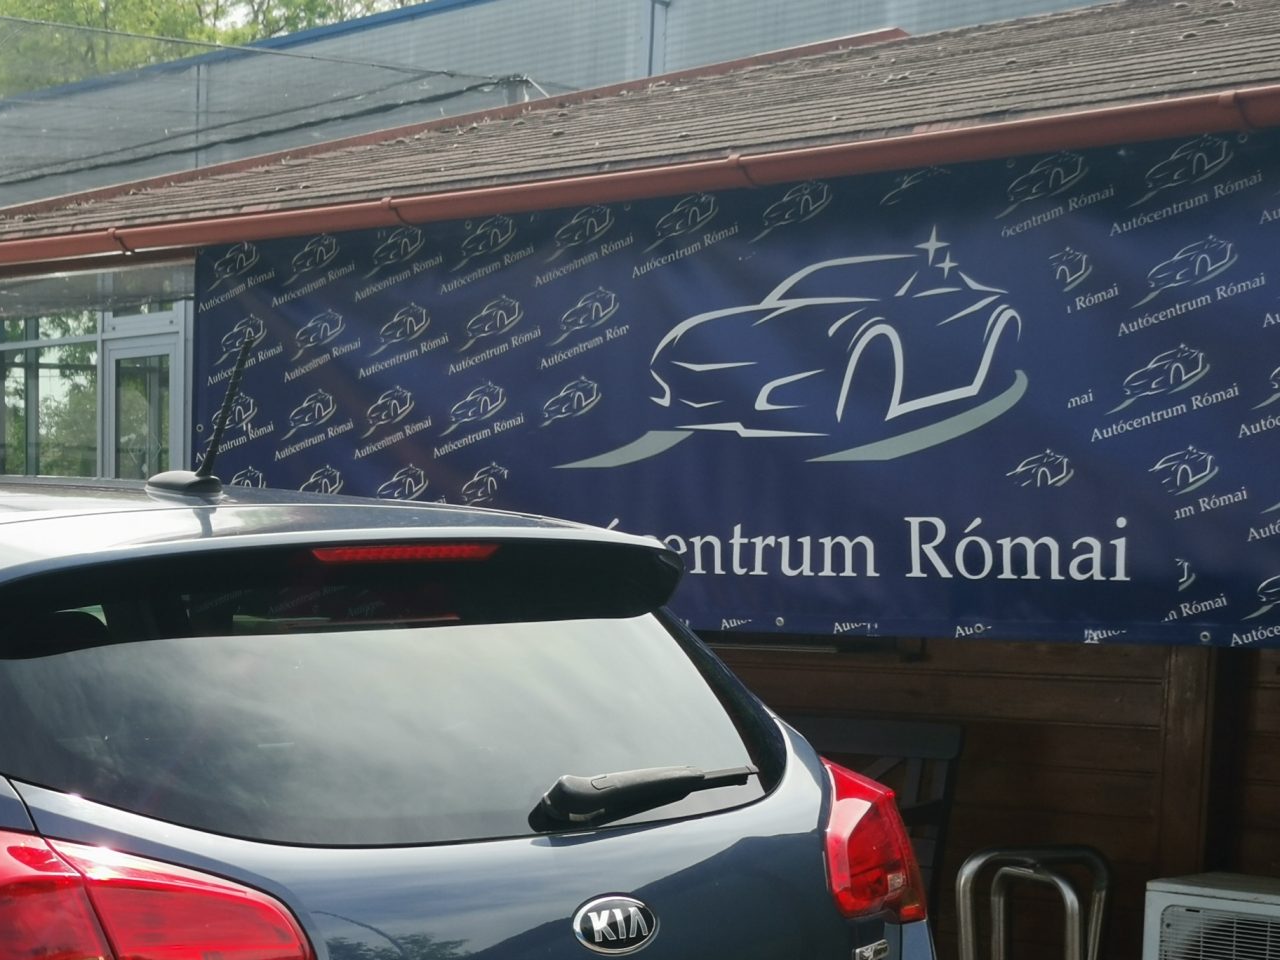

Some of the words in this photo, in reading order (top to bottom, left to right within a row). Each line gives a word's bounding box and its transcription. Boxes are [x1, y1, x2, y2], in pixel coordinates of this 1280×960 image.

[1067, 184, 1115, 212] Római
[1109, 193, 1209, 237] Autócentrum
[1213, 170, 1264, 200] Római
[1075, 282, 1119, 312] Római
[1117, 294, 1212, 338] Autócentrum
[1214, 272, 1267, 302] Római
[1090, 402, 1187, 442] Autócentrum
[1190, 382, 1240, 411] Római
[1198, 486, 1248, 513] Római
[904, 515, 1131, 583] Római
[1179, 593, 1228, 618] Római
[588, 906, 649, 943] KIA
